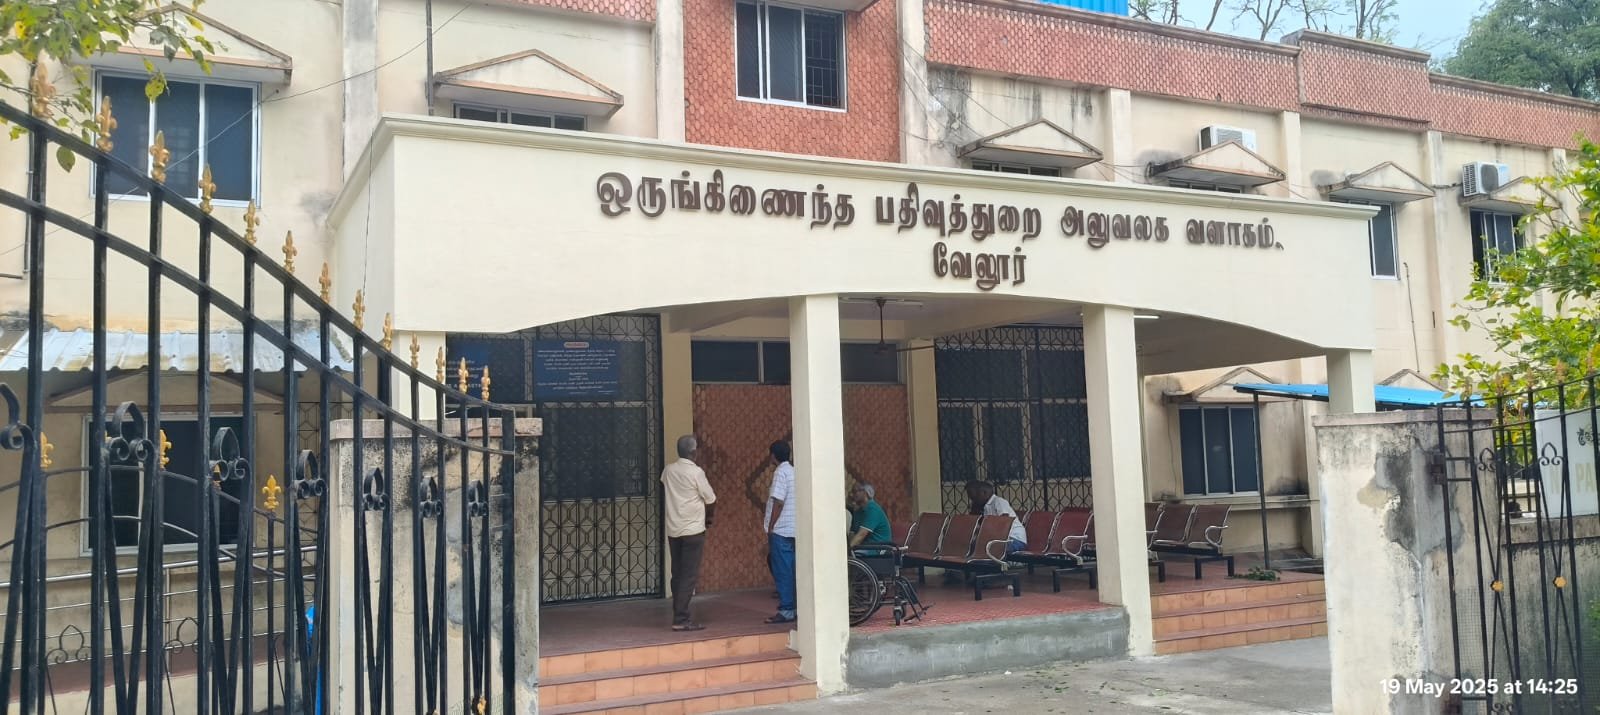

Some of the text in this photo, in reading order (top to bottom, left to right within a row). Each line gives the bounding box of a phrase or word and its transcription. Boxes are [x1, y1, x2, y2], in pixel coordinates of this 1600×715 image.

[596, 168, 856, 231] ஒருங்கிணைந்த
[875, 181, 1042, 244] பதிவுத்துறை
[1060, 205, 1170, 251] அலுவலக
[932, 241, 1027, 293] வேலூர்
